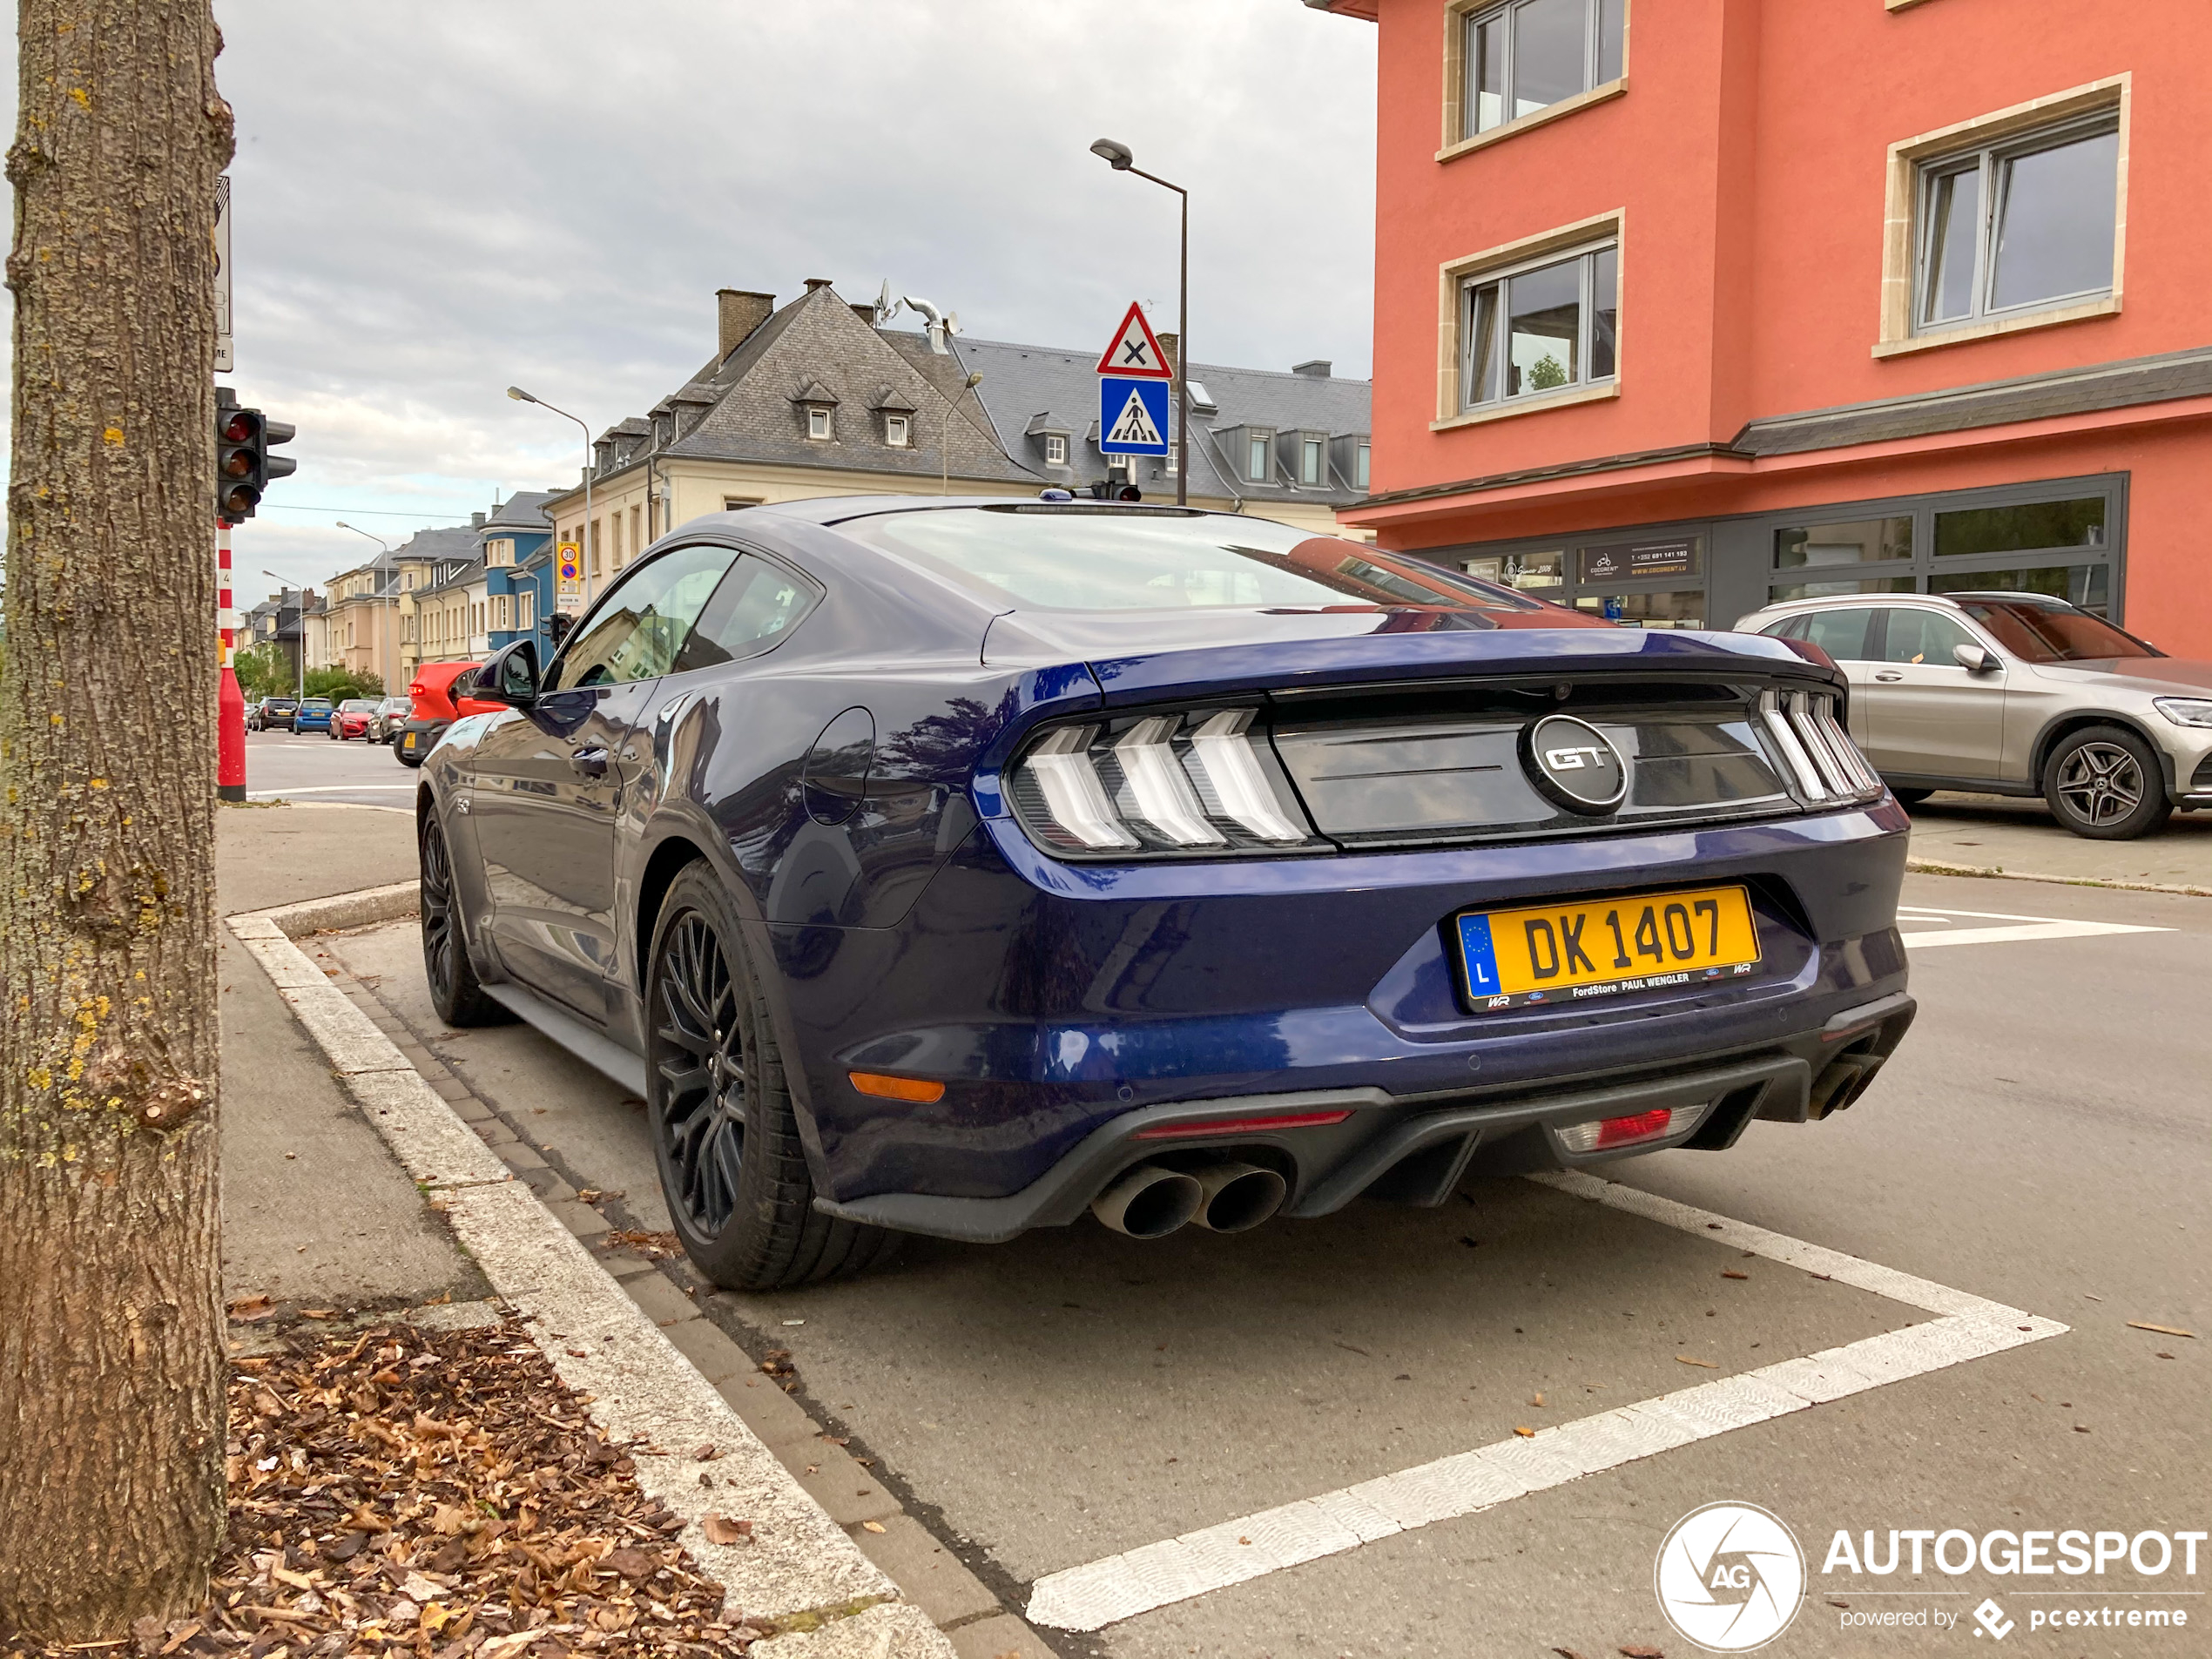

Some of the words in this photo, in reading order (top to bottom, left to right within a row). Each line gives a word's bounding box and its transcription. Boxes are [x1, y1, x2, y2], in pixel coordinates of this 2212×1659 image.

[563, 550, 574, 559] 30
[223, 573, 230, 583] 4
[1545, 747, 1609, 770] GT
[1606, 899, 1719, 968] 1407
[1476, 962, 1489, 984] L
[1572, 983, 1617, 997] FordStore
[1621, 978, 1645, 991] PAUL
[1647, 973, 1689, 988] WENGLER
